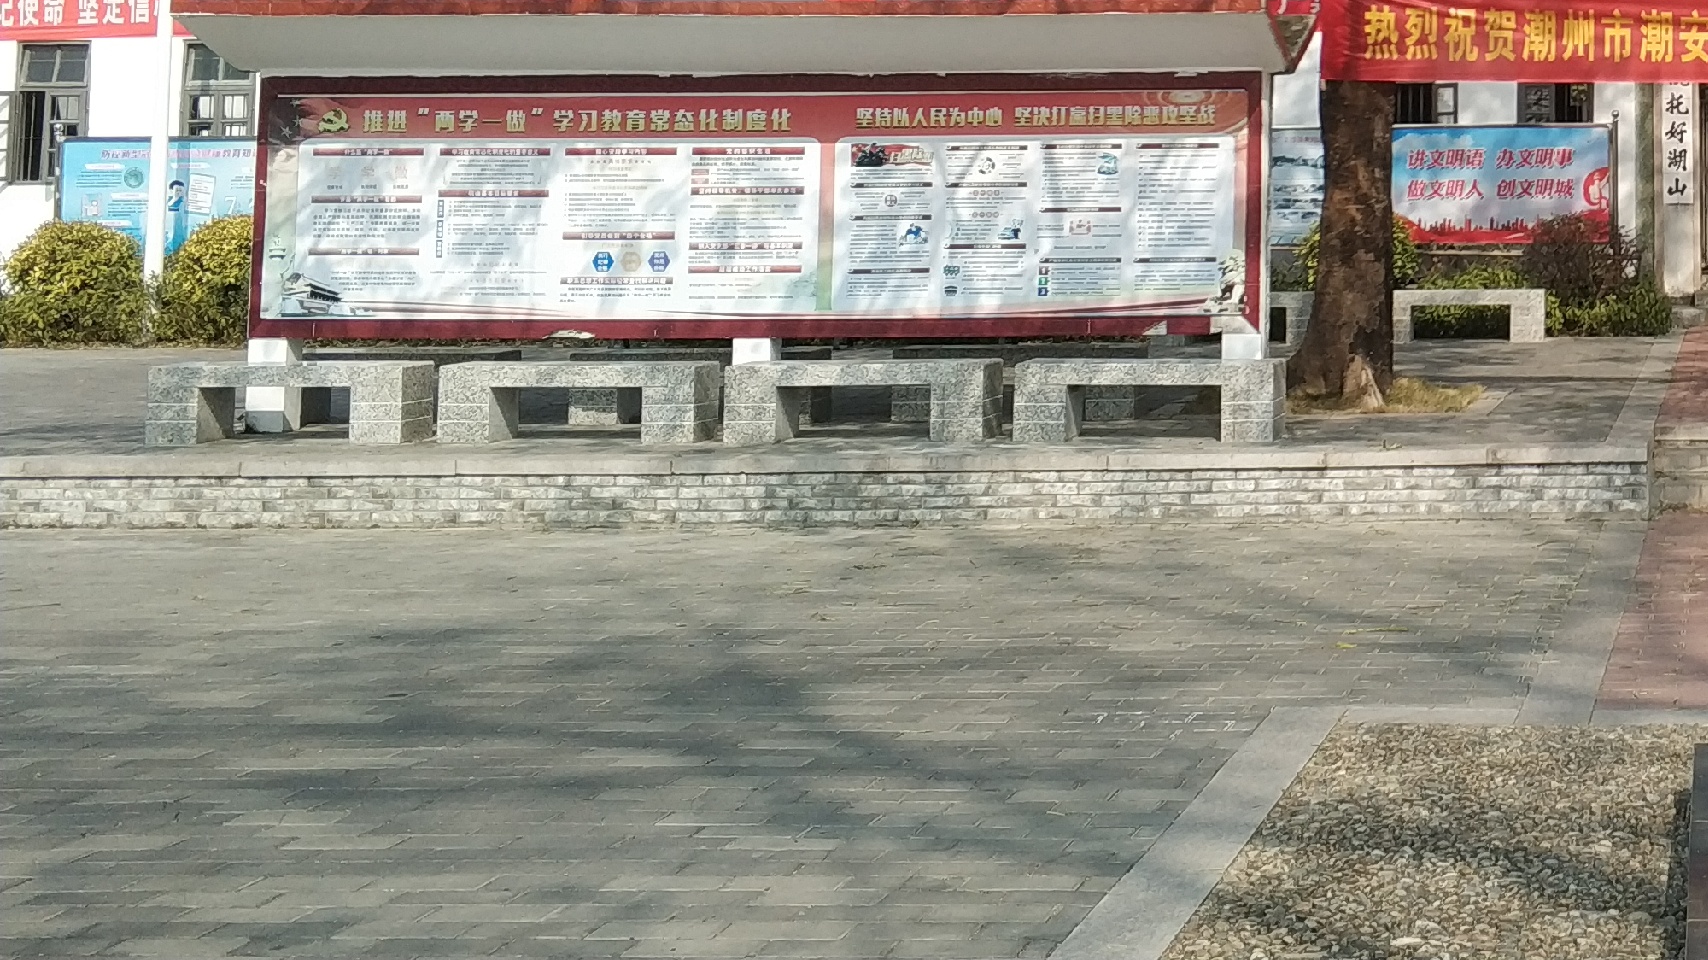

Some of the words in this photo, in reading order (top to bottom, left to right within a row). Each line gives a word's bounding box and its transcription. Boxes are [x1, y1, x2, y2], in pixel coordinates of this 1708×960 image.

[856, 106, 1002, 128] 坚持以人民为中心
[1014, 104, 1216, 127] 坚决打赢扫黑除恶攻坚战
[1665, 82, 1690, 196] 托好湖山
[1407, 149, 1485, 169] 讲文明语
[1495, 149, 1575, 169] 办文明事
[1407, 179, 1485, 200] 做文明人
[1496, 179, 1575, 199] 创文明城
